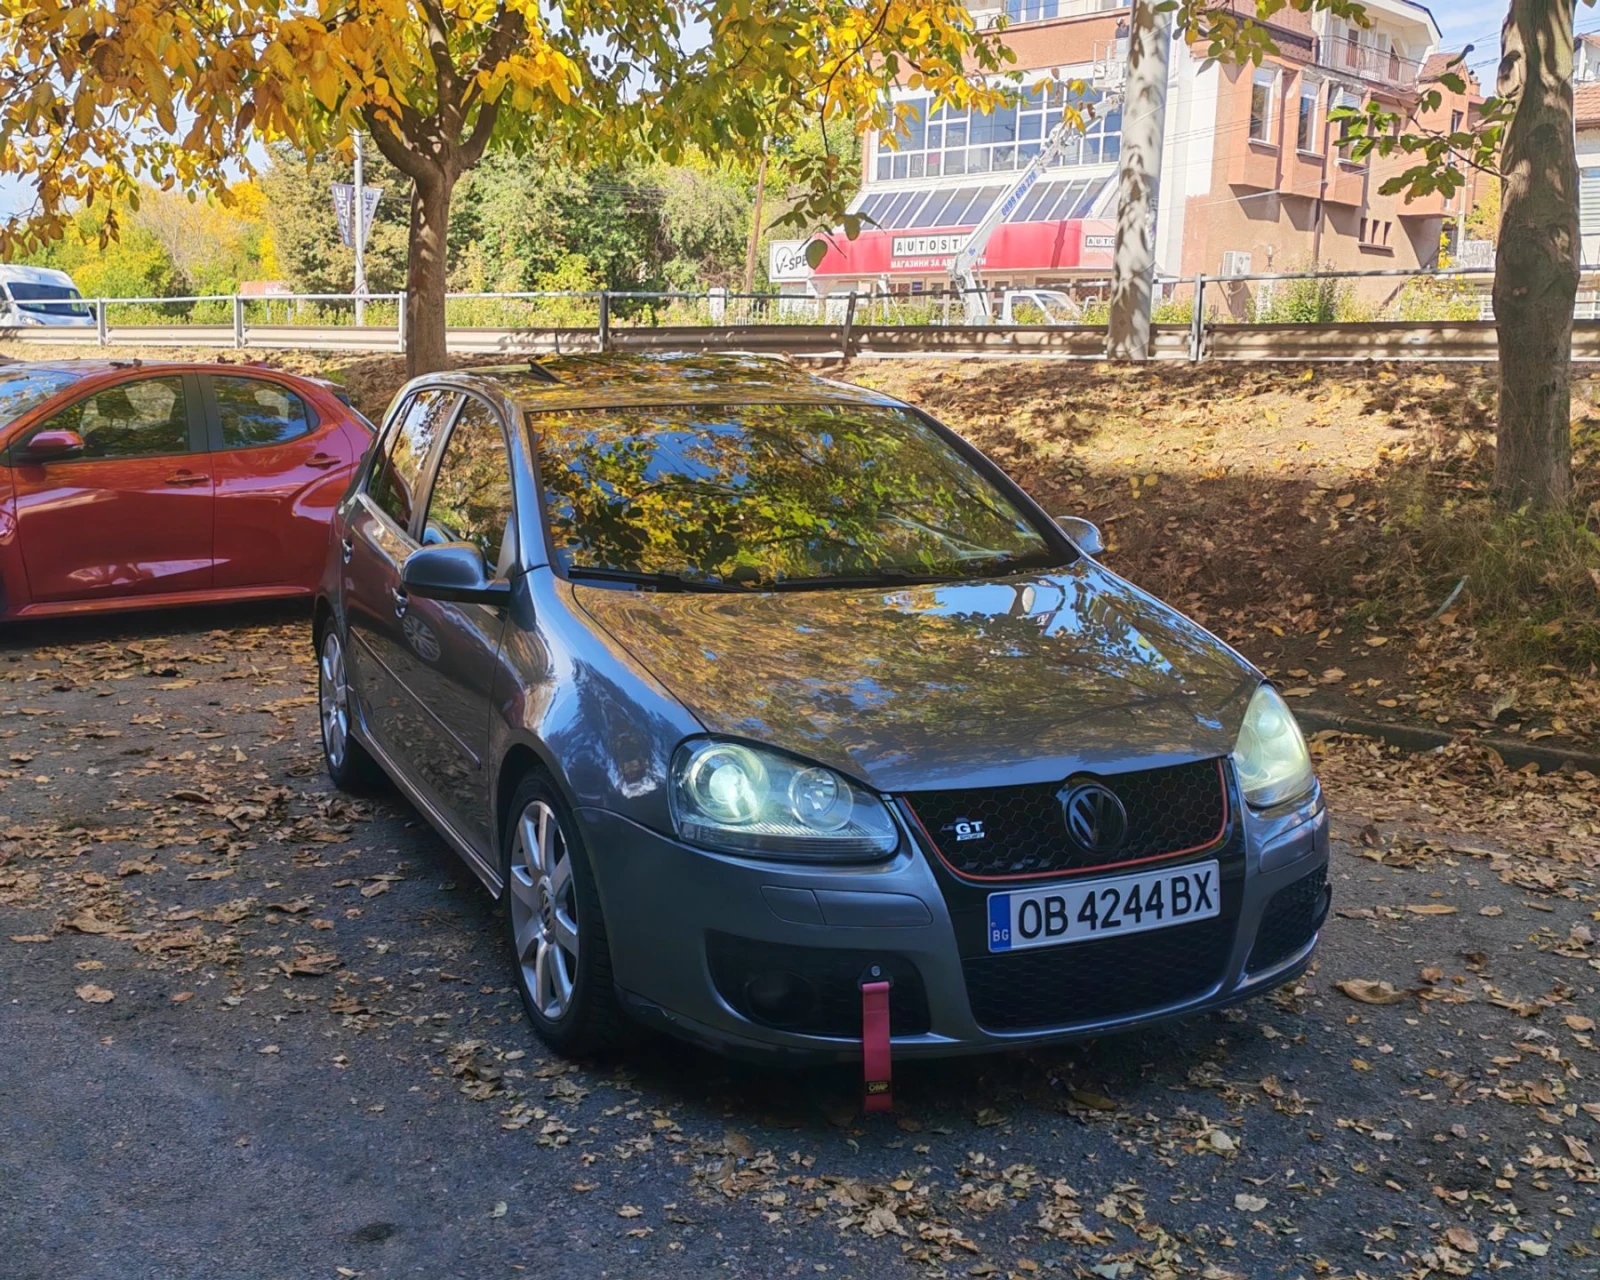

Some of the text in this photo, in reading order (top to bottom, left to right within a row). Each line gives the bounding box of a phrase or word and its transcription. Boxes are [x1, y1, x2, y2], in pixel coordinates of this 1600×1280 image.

[896, 239, 964, 252] AUTOST
[776, 254, 808, 274] V-SPE
[890, 258, 929, 269] МАГАЗИНИ
[956, 821, 982, 834] GT
[1018, 870, 1212, 939] OB 4244 BX
[992, 929, 1009, 942] BG
